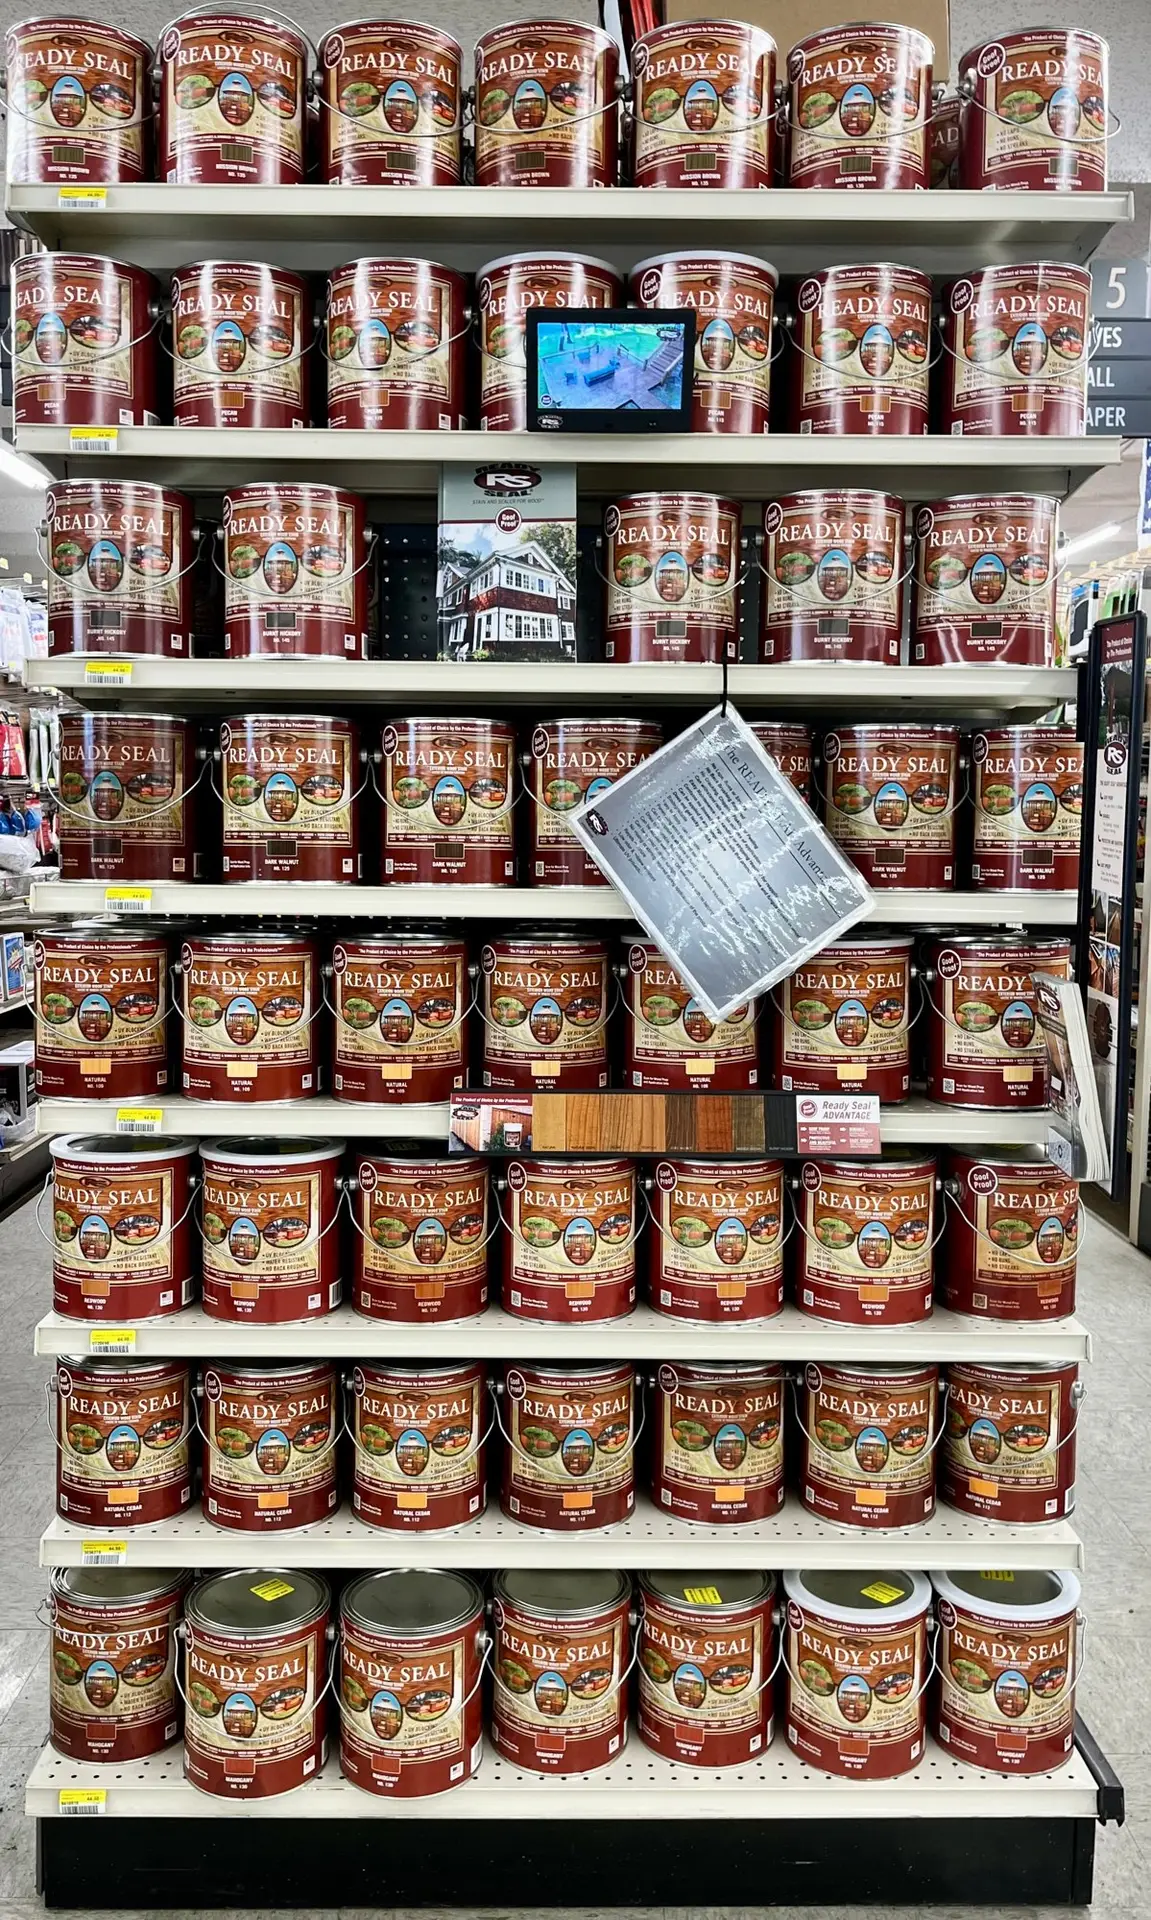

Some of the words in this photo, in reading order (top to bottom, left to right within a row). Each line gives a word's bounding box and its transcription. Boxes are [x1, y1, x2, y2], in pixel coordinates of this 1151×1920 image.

[16, 49, 77, 70] READY
[84, 51, 132, 79] SEAL
[177, 47, 244, 67] READY
[252, 49, 295, 79] SEAL
[342, 52, 408, 73] READY
[416, 56, 455, 87] SEAL
[481, 53, 538, 83] READY
[545, 52, 594, 74] SEAL
[646, 54, 712, 81] READY
[719, 54, 760, 79] SEAL
[802, 57, 866, 86] READY
[1002, 61, 1073, 83] READY
[1078, 64, 1104, 87] SEA
[64, 286, 116, 307] SEAL
[1106, 267, 1126, 309] 5
[179, 294, 238, 317] READY
[244, 295, 291, 318] SEAL
[331, 290, 384, 317] READY
[388, 292, 438, 313] SEAL
[489, 291, 549, 317] READY
[556, 291, 597, 308] SEAL
[660, 289, 727, 309] READY
[734, 294, 769, 319] SEAL
[818, 297, 885, 319] READY
[893, 300, 927, 321] SEAL
[970, 295, 1040, 318] READY
[1047, 296, 1083, 318] SEAL
[486, 473, 532, 487] RS
[54, 514, 114, 530] READY
[120, 515, 168, 536] SEAL
[230, 516, 289, 534] READY
[295, 517, 342, 537] SEAL
[618, 526, 681, 545] READY
[687, 527, 728, 545] SEAL
[779, 523, 844, 542] READY
[851, 523, 893, 543] SEAL
[930, 527, 998, 547] READY
[1005, 527, 1046, 544] SEAL
[62, 745, 113, 762] READY
[120, 746, 170, 763] SEAL
[229, 748, 288, 765] READY
[295, 748, 340, 764] SEAL
[395, 751, 459, 767] READY
[464, 752, 505, 768] SEAL
[546, 752, 610, 768] READY
[617, 752, 654, 768] SEA
[1108, 747, 1123, 764] RS
[837, 758, 901, 773] READY
[908, 757, 947, 773] SEAL
[984, 758, 1048, 773] READY
[1055, 758, 1084, 773] SEA
[1106, 767, 1122, 775] SEAL
[43, 967, 104, 984] READY
[110, 967, 155, 982] SEAL
[190, 969, 250, 987] READY
[256, 970, 301, 986] SEAL
[345, 972, 405, 989] READY
[412, 972, 453, 988] SEAL
[494, 972, 555, 988] READY
[561, 971, 599, 987] SEAL
[795, 974, 859, 990] READY
[866, 972, 903, 988] SEAL
[958, 975, 1024, 991] READY
[823, 1101, 849, 1110] Ready
[973, 1173, 989, 1181] Goof
[974, 1181, 992, 1189] Proof
[54, 1188, 102, 1205] READY
[109, 1189, 158, 1205] SEAL
[204, 1188, 252, 1207] READY
[258, 1190, 306, 1207] SEAL
[375, 1192, 441, 1208] READY
[445, 1189, 482, 1207] SEAL
[524, 1189, 589, 1208] READY
[594, 1187, 630, 1207] SEAL
[675, 1190, 739, 1208] READY
[745, 1187, 778, 1206] SEAL
[819, 1191, 884, 1211] READY
[890, 1193, 927, 1210] SEAL
[994, 1192, 1059, 1208] READY
[70, 1397, 132, 1417] READY
[138, 1391, 180, 1414] SEAL
[218, 1401, 283, 1420] READY
[288, 1395, 328, 1417] SEAL
[363, 1400, 421, 1418] READY
[426, 1398, 470, 1419] SEAL
[523, 1398, 588, 1420] READY
[591, 1395, 628, 1417] SEAL
[675, 1393, 739, 1414] READY
[744, 1392, 779, 1413] SEAL
[819, 1393, 883, 1417] READY
[888, 1395, 927, 1416] SEAL
[950, 1384, 993, 1411] EADY
[999, 1398, 1047, 1415] SEAL
[54, 1629, 110, 1650] READY
[115, 1626, 165, 1650] SEAL
[502, 1632, 560, 1662] READY
[566, 1640, 610, 1664] SEAL
[644, 1621, 699, 1655] READY
[704, 1637, 750, 1655] SEAL
[802, 1631, 864, 1666] READY
[869, 1646, 912, 1666] SEAL
[954, 1630, 1021, 1660] READY
[1027, 1638, 1066, 1660] SEAL
[192, 1657, 250, 1682] READY
[255, 1657, 303, 1683] SEAL
[343, 1650, 395, 1682] READY
[400, 1662, 450, 1682] SEAL
